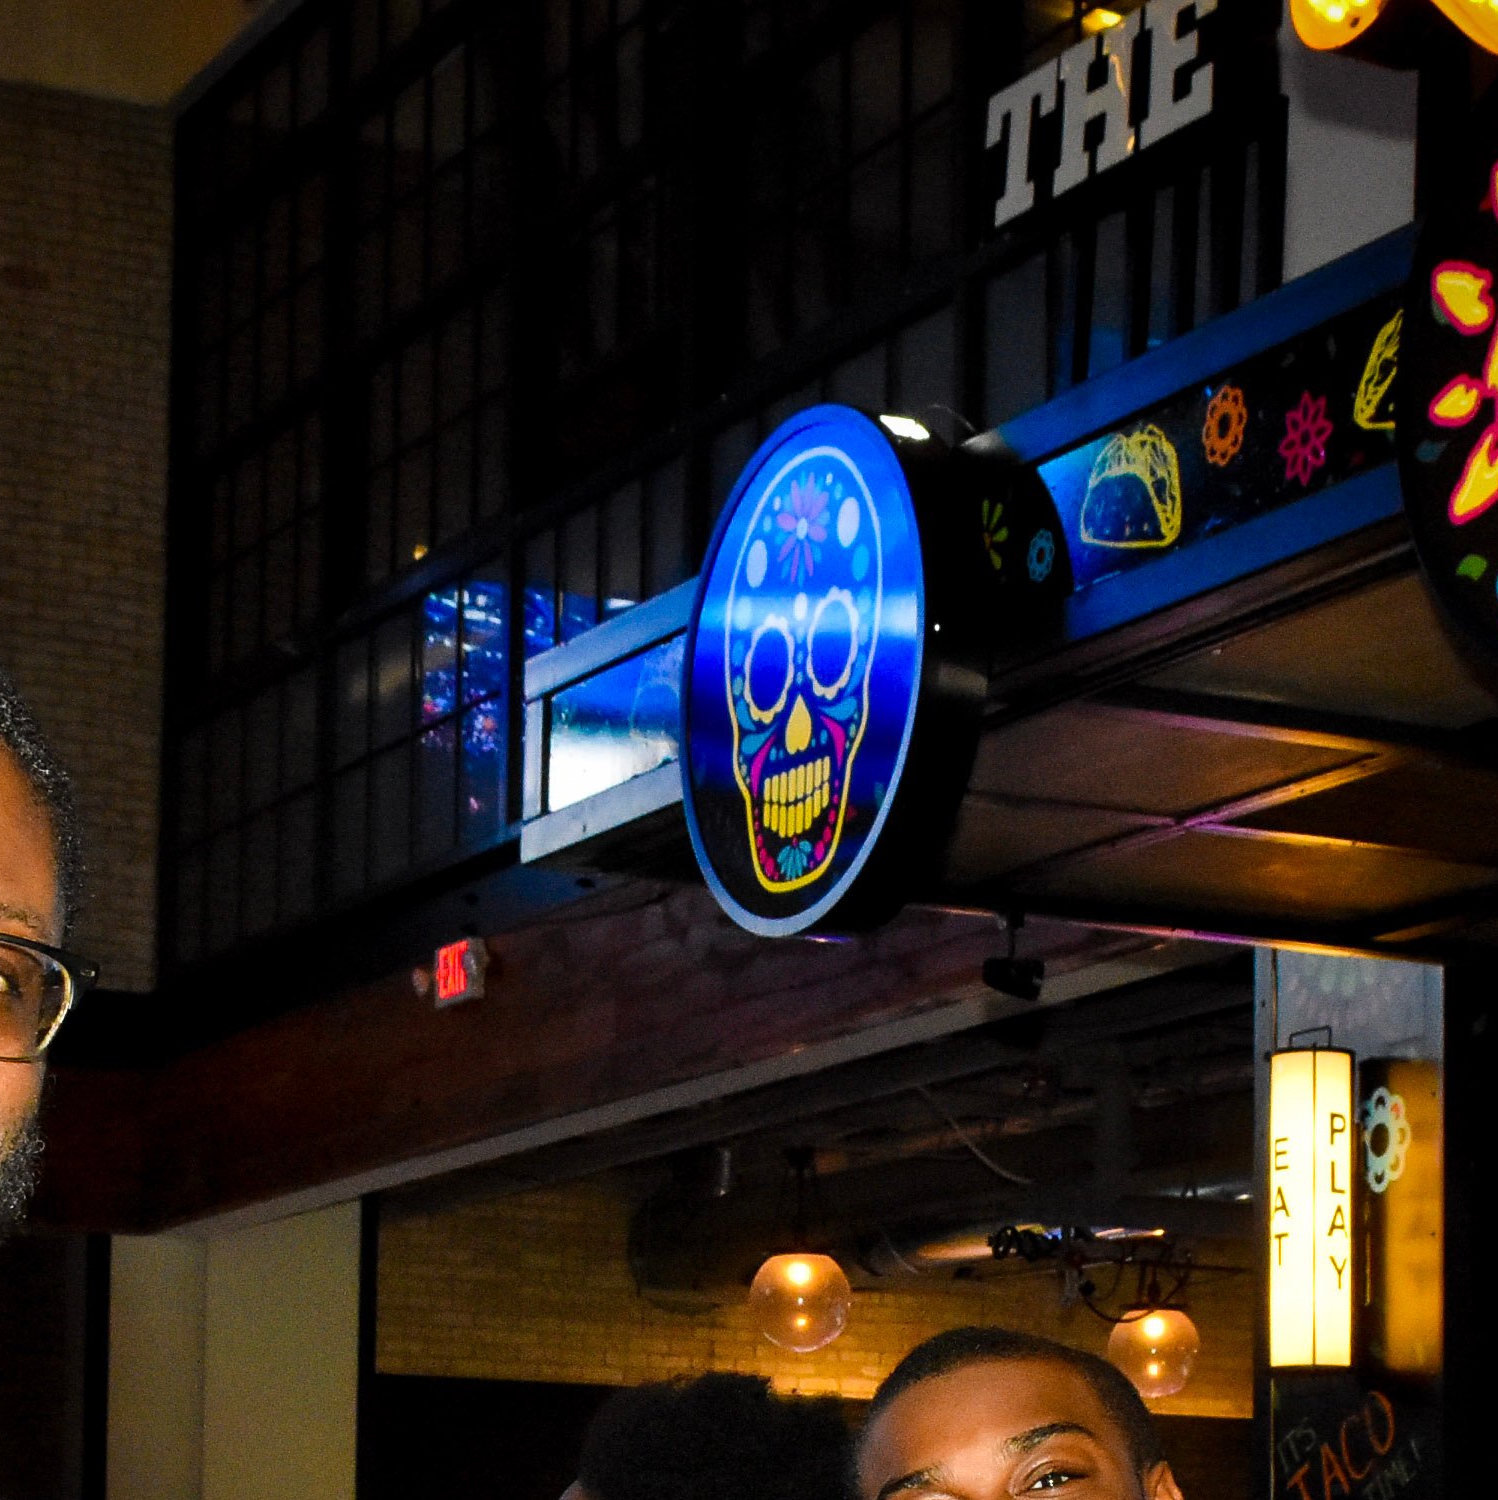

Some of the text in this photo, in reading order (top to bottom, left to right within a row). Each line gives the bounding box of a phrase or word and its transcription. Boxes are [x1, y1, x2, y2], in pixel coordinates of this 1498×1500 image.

[985, 0, 1218, 228] THE
[1274, 1137, 1290, 1266] EAT
[1327, 1112, 1348, 1290] PLAY
